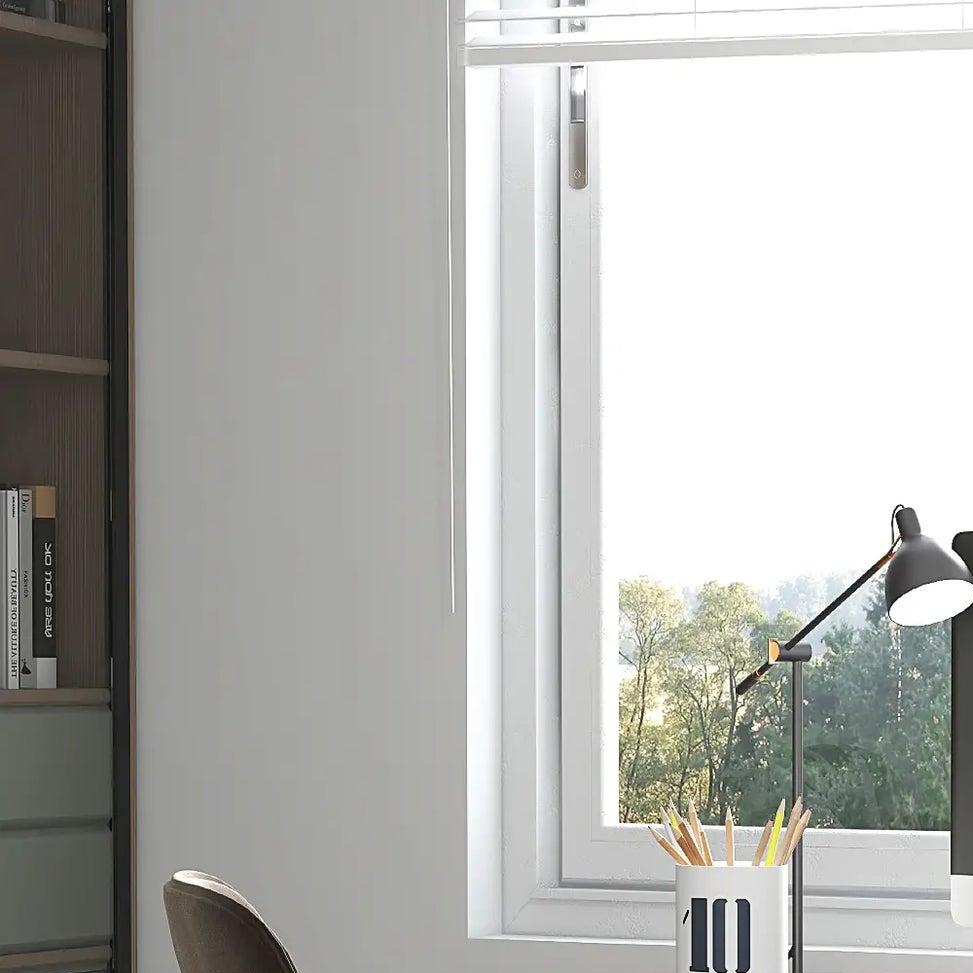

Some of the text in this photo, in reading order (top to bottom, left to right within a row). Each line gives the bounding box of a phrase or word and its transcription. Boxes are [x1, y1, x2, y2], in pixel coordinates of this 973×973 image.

[21, 493, 30, 513] Dior
[44, 542, 52, 566] OK
[44, 606, 53, 638] ARE
